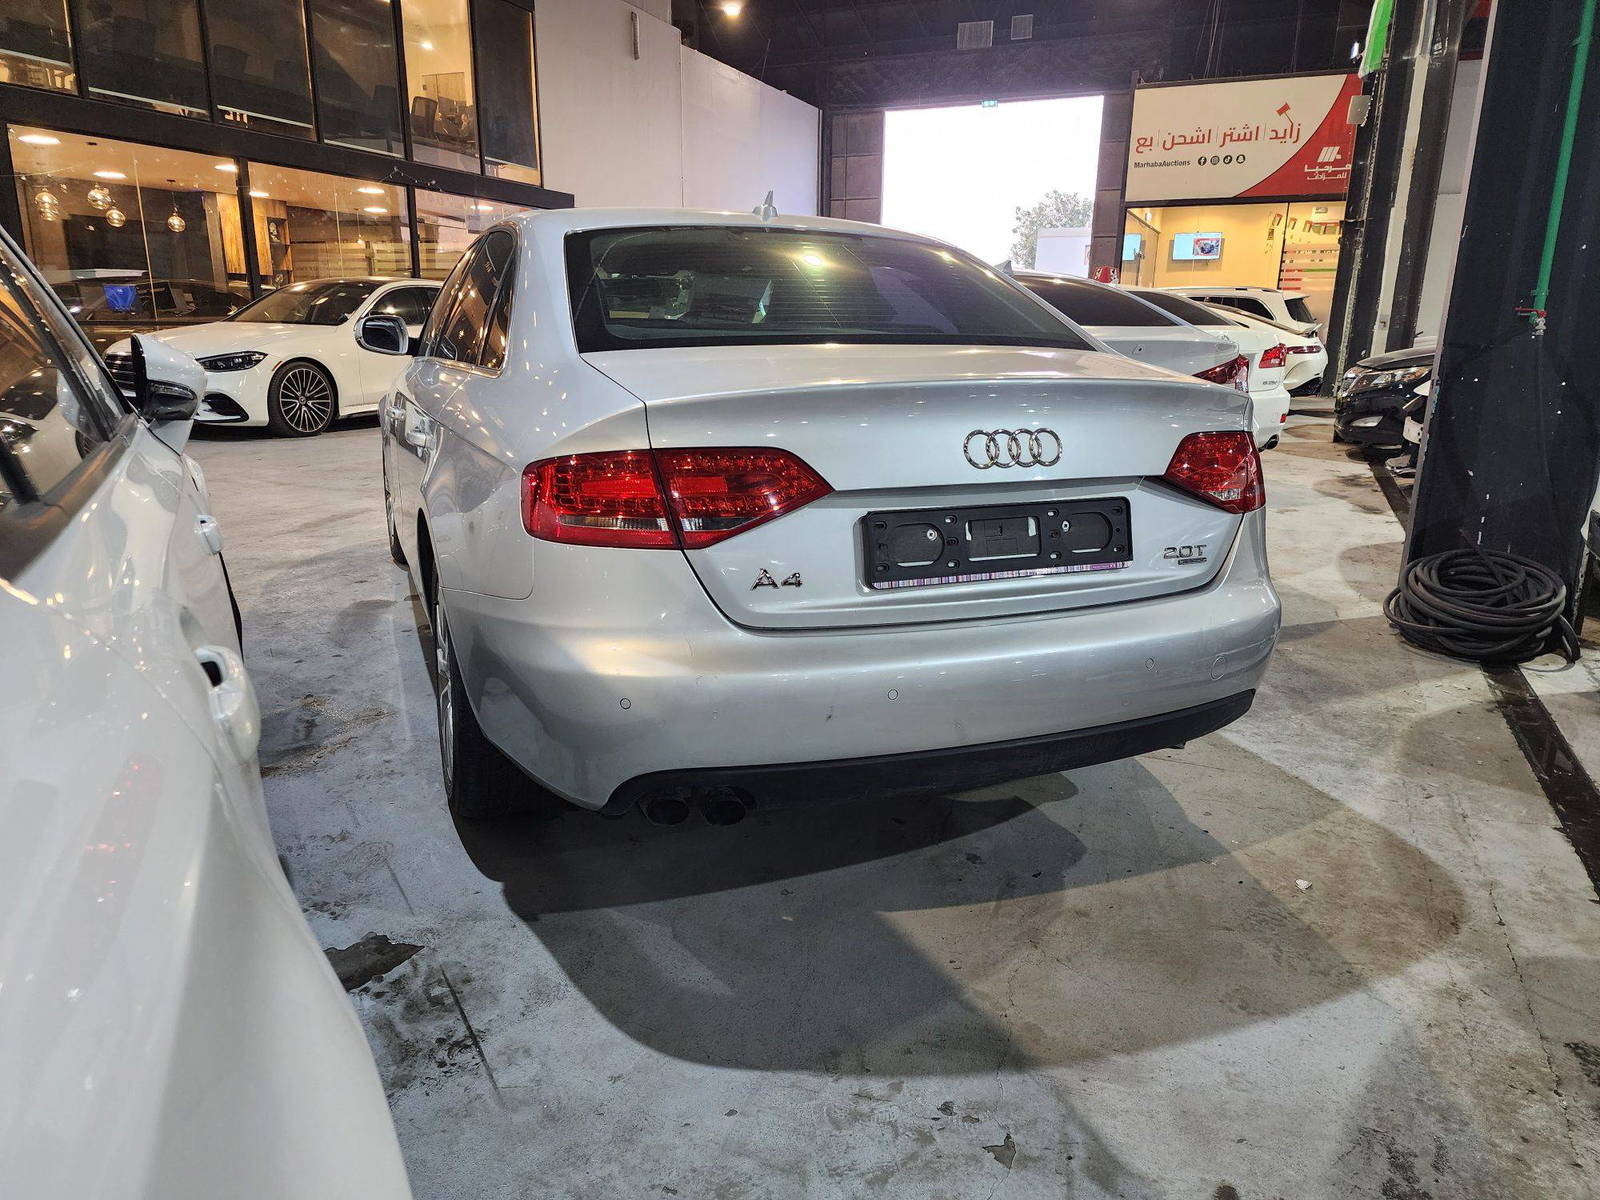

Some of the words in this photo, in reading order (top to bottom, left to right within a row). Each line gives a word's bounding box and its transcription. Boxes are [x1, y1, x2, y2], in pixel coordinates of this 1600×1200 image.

[1135, 135, 1153, 154] بع
[1162, 126, 1212, 151] اشحن
[1219, 124, 1260, 148] اشتر
[1269, 122, 1301, 144] زايد
[1133, 159, 1191, 169] MarhabaAuctions
[750, 567, 803, 591] A4
